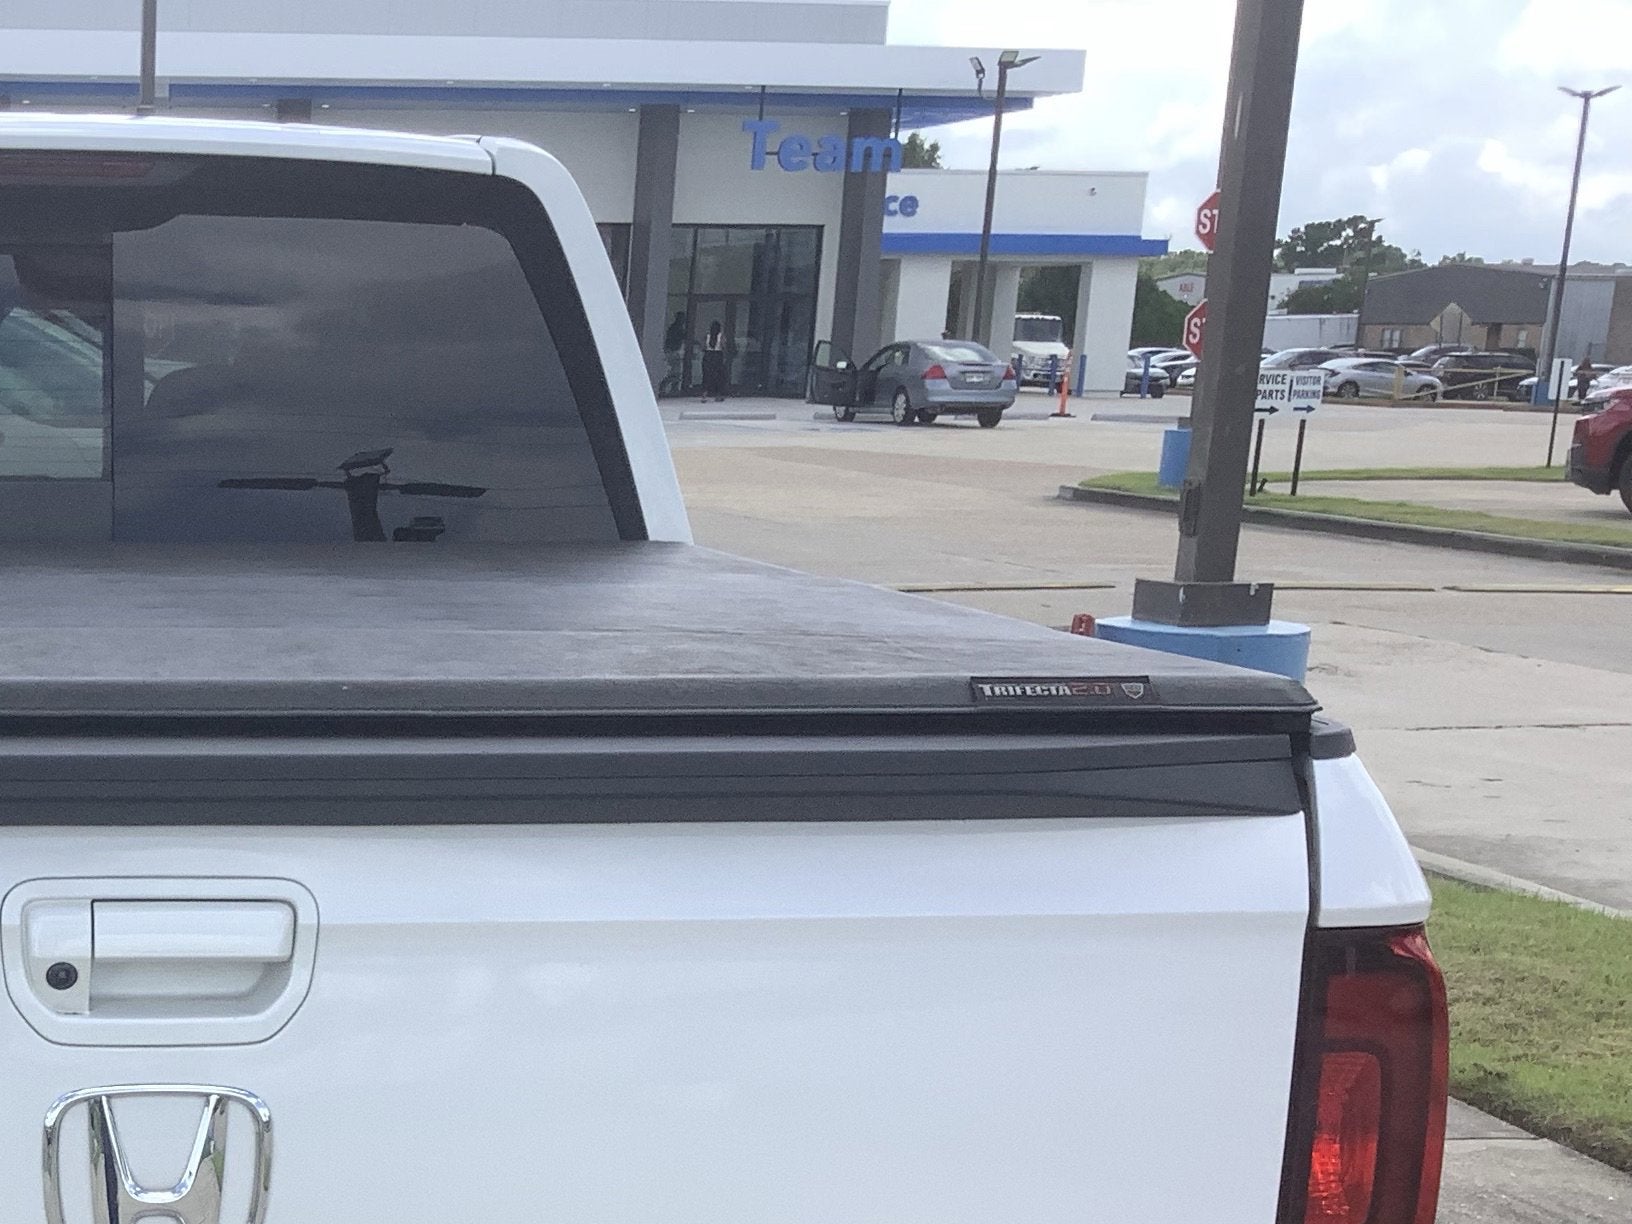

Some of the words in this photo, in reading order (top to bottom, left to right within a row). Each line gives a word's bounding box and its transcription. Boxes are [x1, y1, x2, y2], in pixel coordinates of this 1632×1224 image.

[743, 119, 903, 173] Team
[882, 195, 919, 217] ce
[1198, 209, 1219, 234] ST
[1259, 374, 1287, 385] RVICE
[1295, 376, 1321, 386] VISITOR
[1256, 389, 1286, 400] PARTS
[1292, 389, 1321, 400] PARKING
